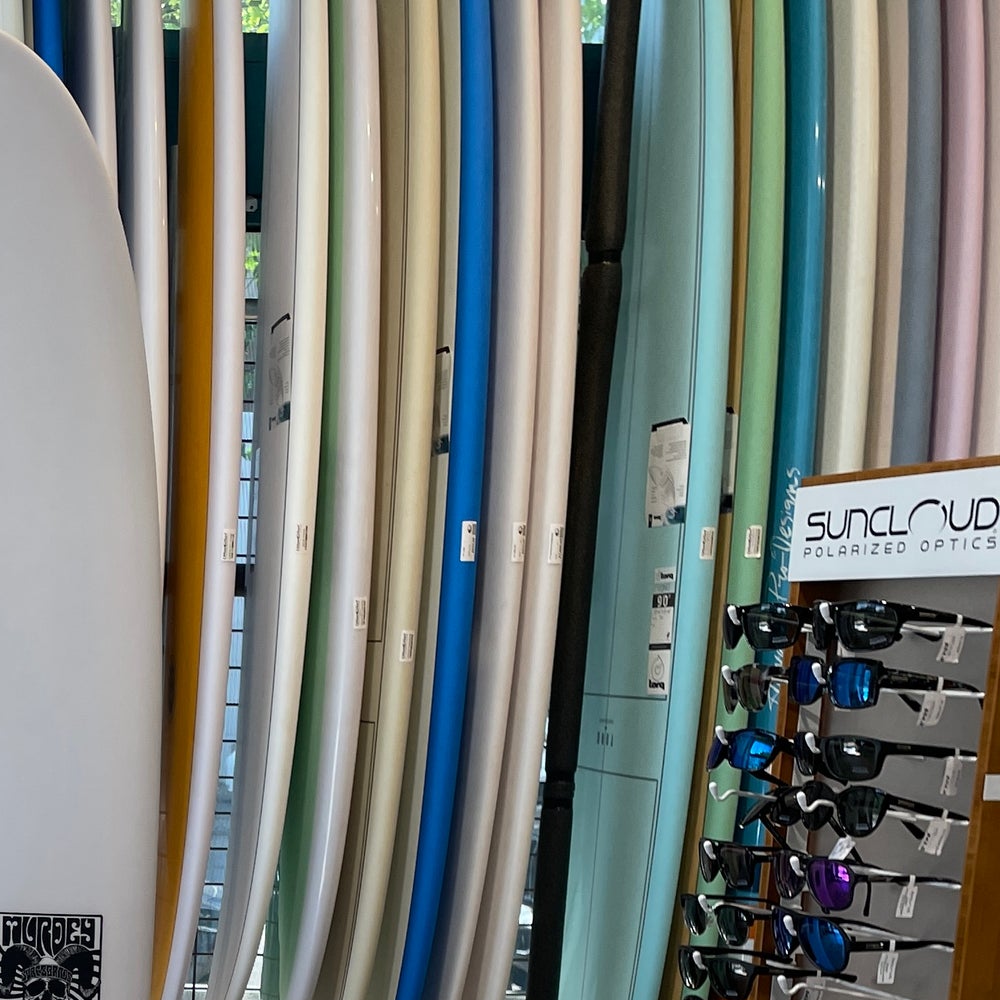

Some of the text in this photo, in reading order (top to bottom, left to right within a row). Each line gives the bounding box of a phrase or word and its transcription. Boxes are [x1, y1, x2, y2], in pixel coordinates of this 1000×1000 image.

[805, 497, 1000, 542] SUNCLOUD
[803, 536, 997, 558] POLARIZED OPTICS
[648, 679, 666, 690] torq
